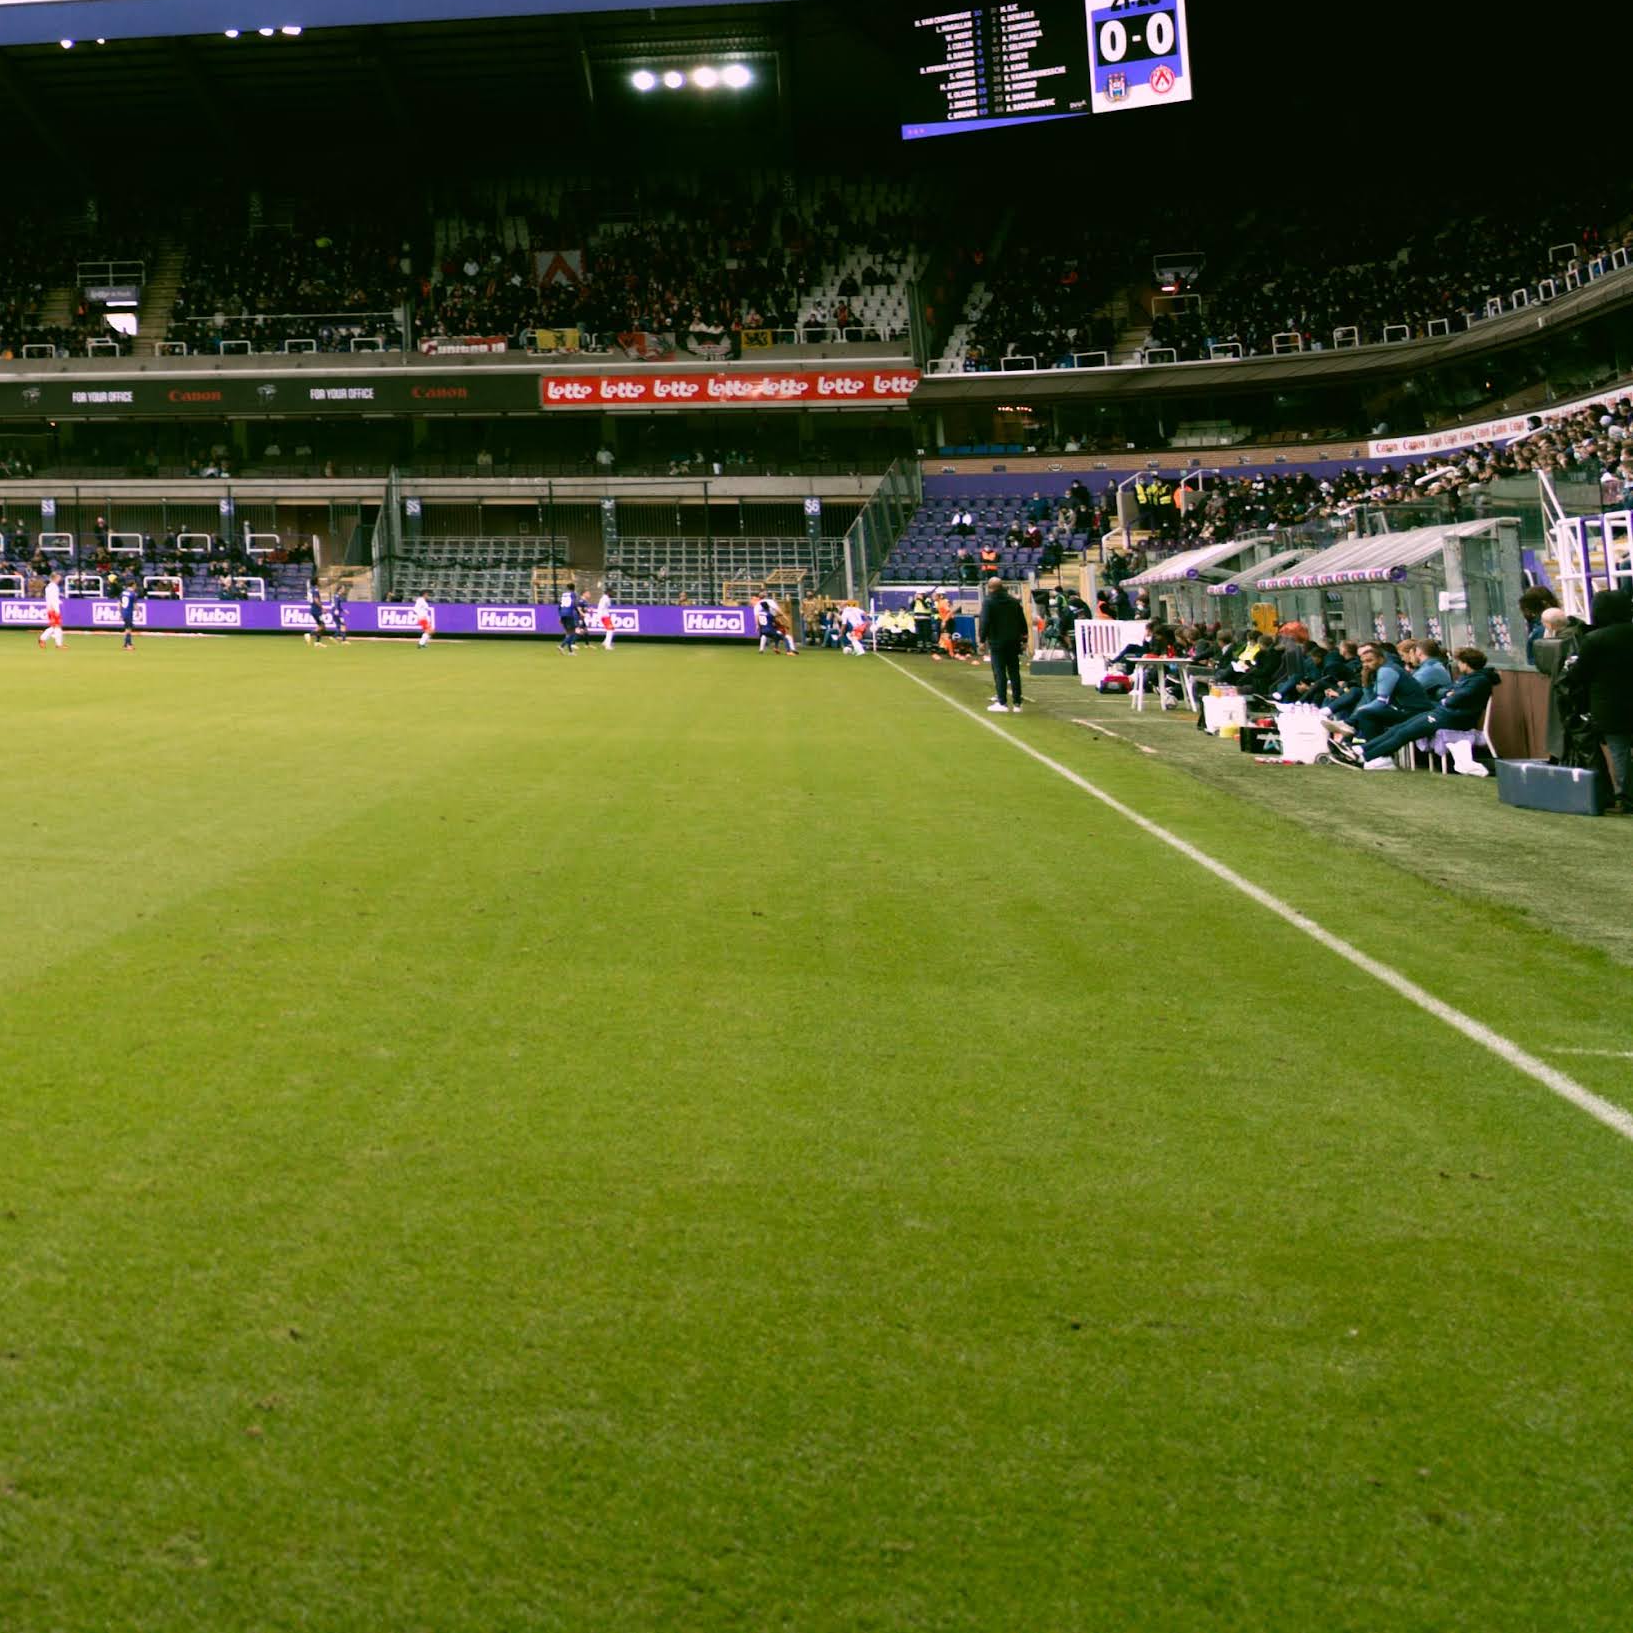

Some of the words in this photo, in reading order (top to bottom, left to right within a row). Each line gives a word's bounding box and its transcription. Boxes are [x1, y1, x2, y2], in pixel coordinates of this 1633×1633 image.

[1100, 20, 1126, 62] 0
[1146, 12, 1175, 55] 0
[72, 392, 86, 402] FOR
[87, 392, 107, 402] YOUR
[107, 392, 132, 402] OFFICE
[167, 389, 222, 401] Canon
[310, 389, 325, 399] FOR
[326, 388, 346, 399] YOUR
[347, 388, 373, 399] OFFICE
[411, 387, 468, 399] Canon
[804, 499, 819, 513] S6
[188, 608, 237, 623] Hubo
[382, 609, 420, 625] Hub
[480, 612, 531, 627] Hubo
[686, 614, 739, 630] Hubo
